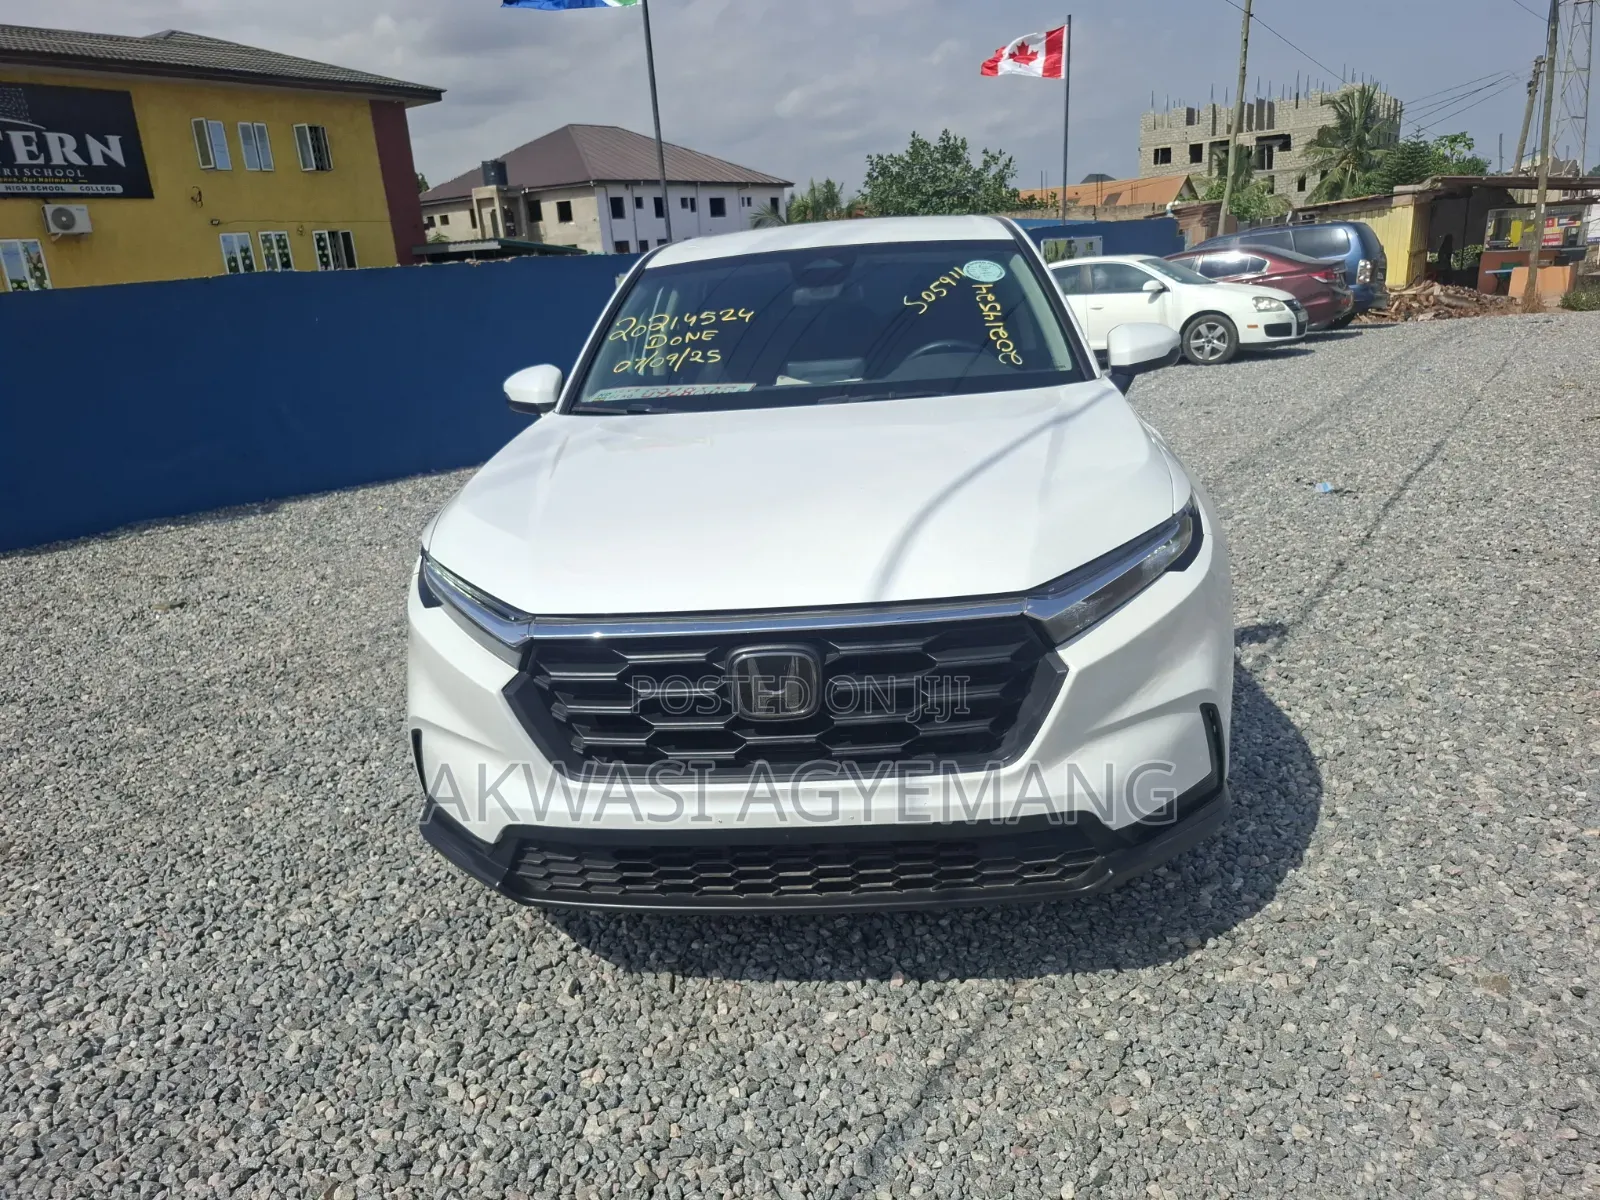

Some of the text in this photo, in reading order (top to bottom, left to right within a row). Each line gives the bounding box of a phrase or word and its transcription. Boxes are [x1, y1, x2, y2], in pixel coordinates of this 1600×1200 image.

[0, 130, 126, 167] ERN
[23, 168, 84, 177] SCHOOL
[608, 308, 755, 342] 20214524
[645, 330, 719, 350] DONE
